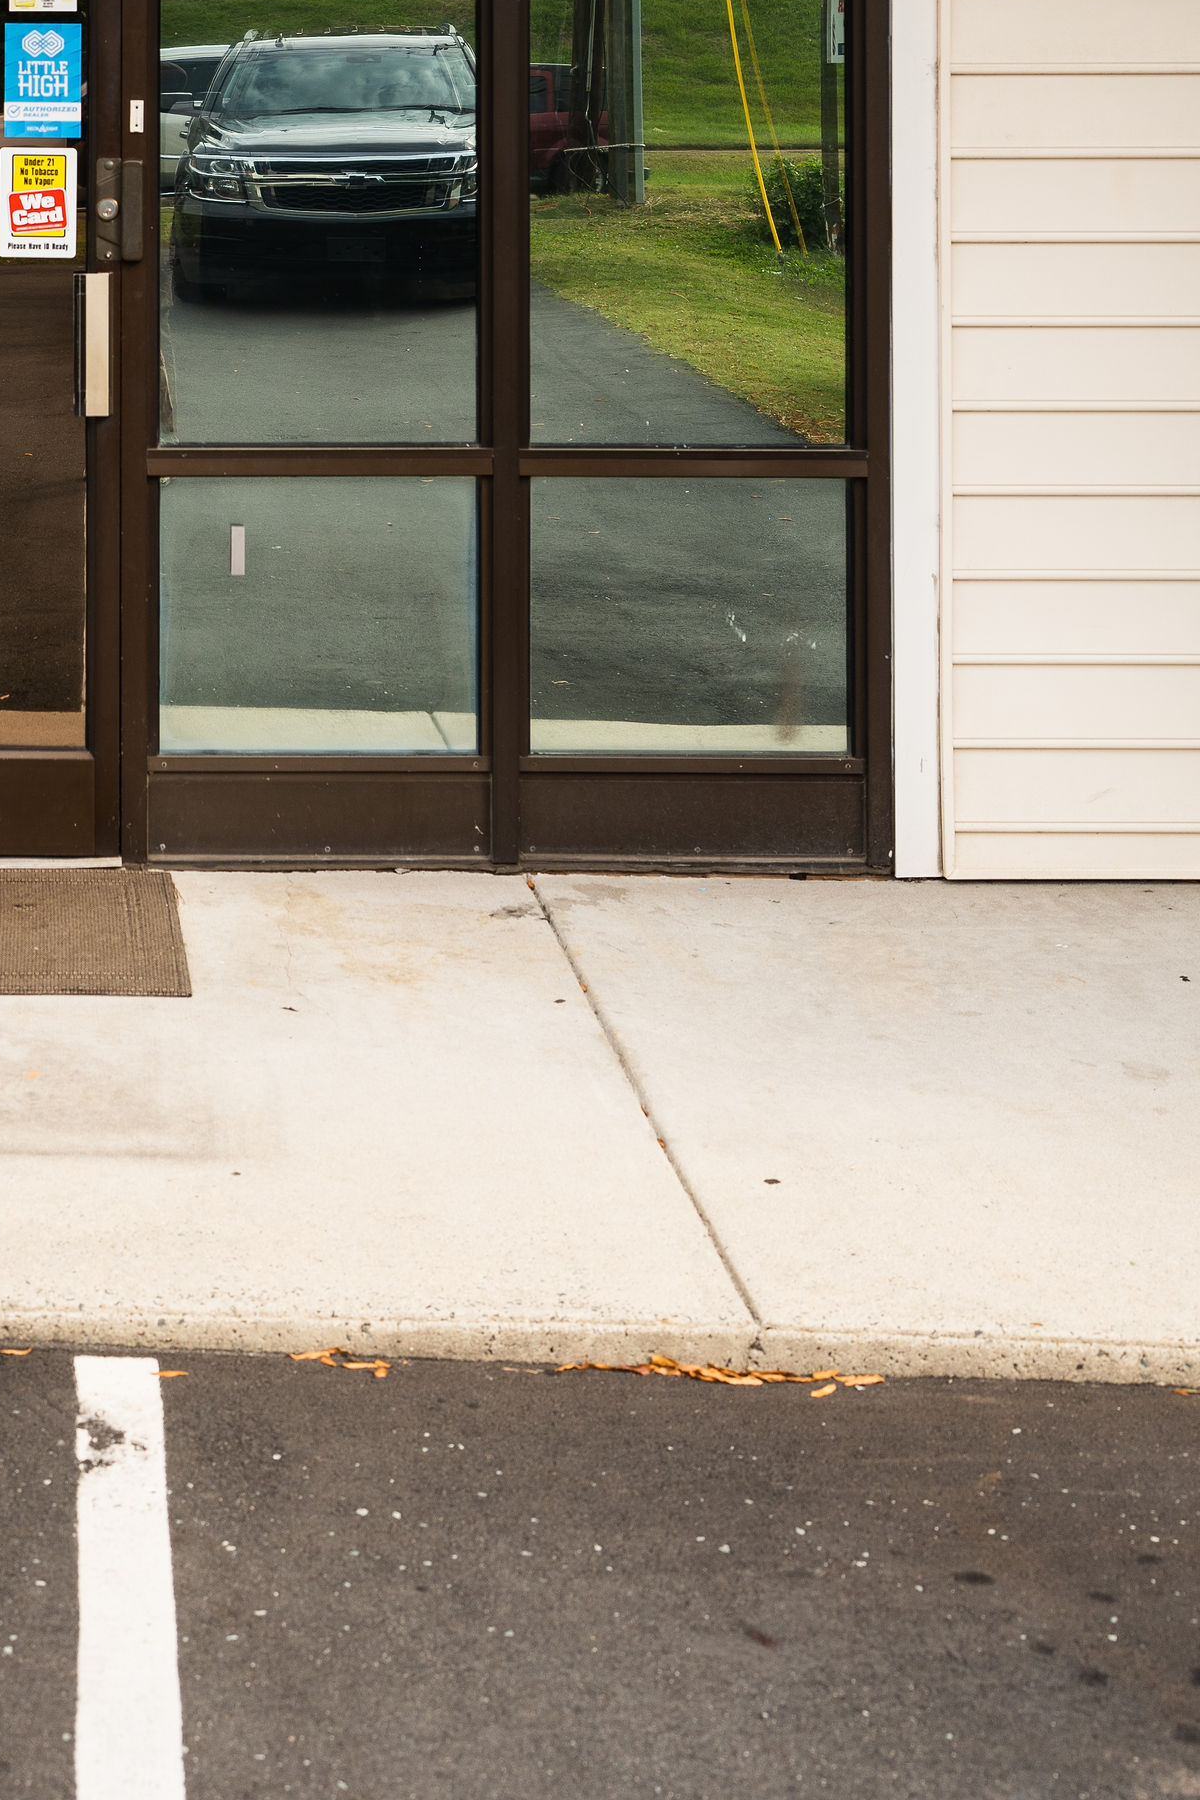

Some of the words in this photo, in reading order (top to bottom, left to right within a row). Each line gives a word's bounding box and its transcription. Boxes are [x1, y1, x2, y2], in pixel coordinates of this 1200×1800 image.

[18, 61, 69, 75] LITTLE
[18, 74, 69, 97] HIGH
[24, 158, 44, 166] Under
[47, 158, 55, 166] 21
[20, 167, 28, 176] No
[31, 167, 59, 176] Tobacco
[24, 177, 32, 185] No
[35, 177, 55, 186] Vapor
[19, 193, 56, 210] We
[12, 206, 64, 226] Card
[8, 242, 26, 250] Please
[52, 243, 69, 251] Ready
